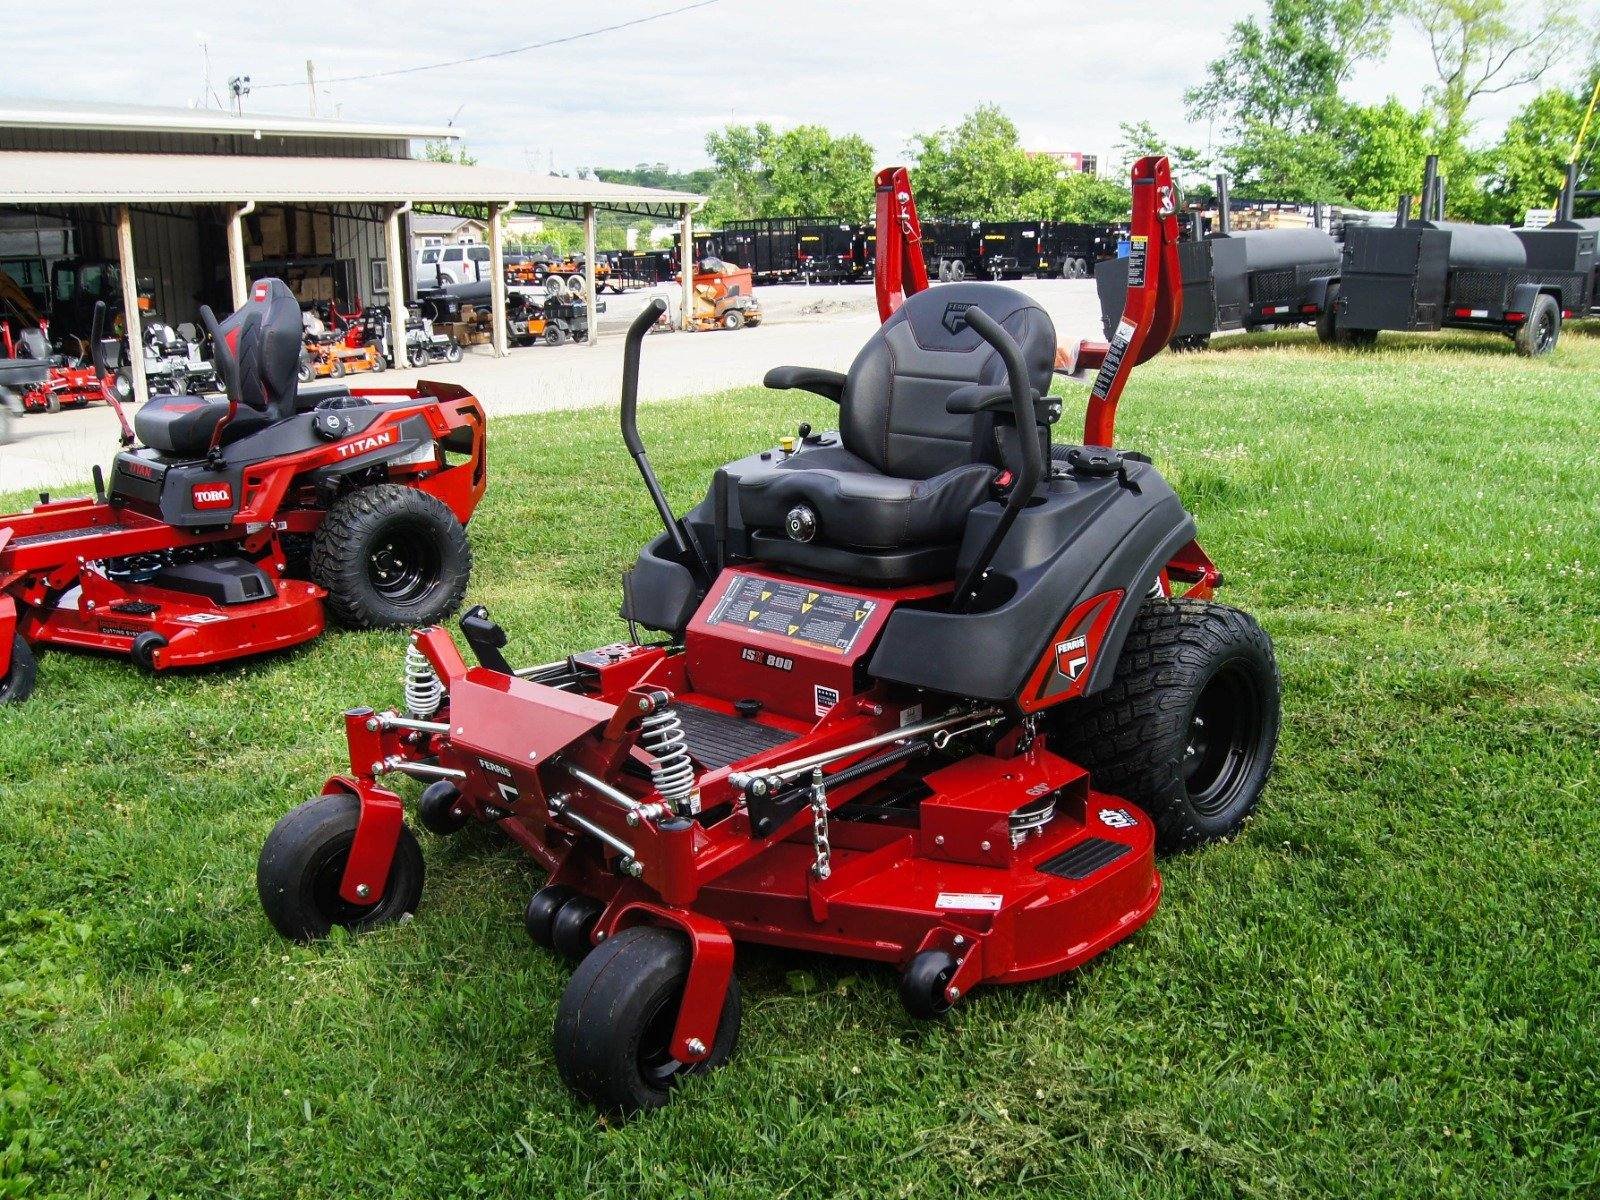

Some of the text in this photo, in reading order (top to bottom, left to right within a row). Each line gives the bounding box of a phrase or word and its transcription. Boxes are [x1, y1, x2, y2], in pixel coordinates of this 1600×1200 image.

[337, 432, 390, 457] TITAN
[1057, 637, 1085, 654] FERRIS
[766, 655, 793, 670] 800
[479, 759, 512, 778] FERRIS
